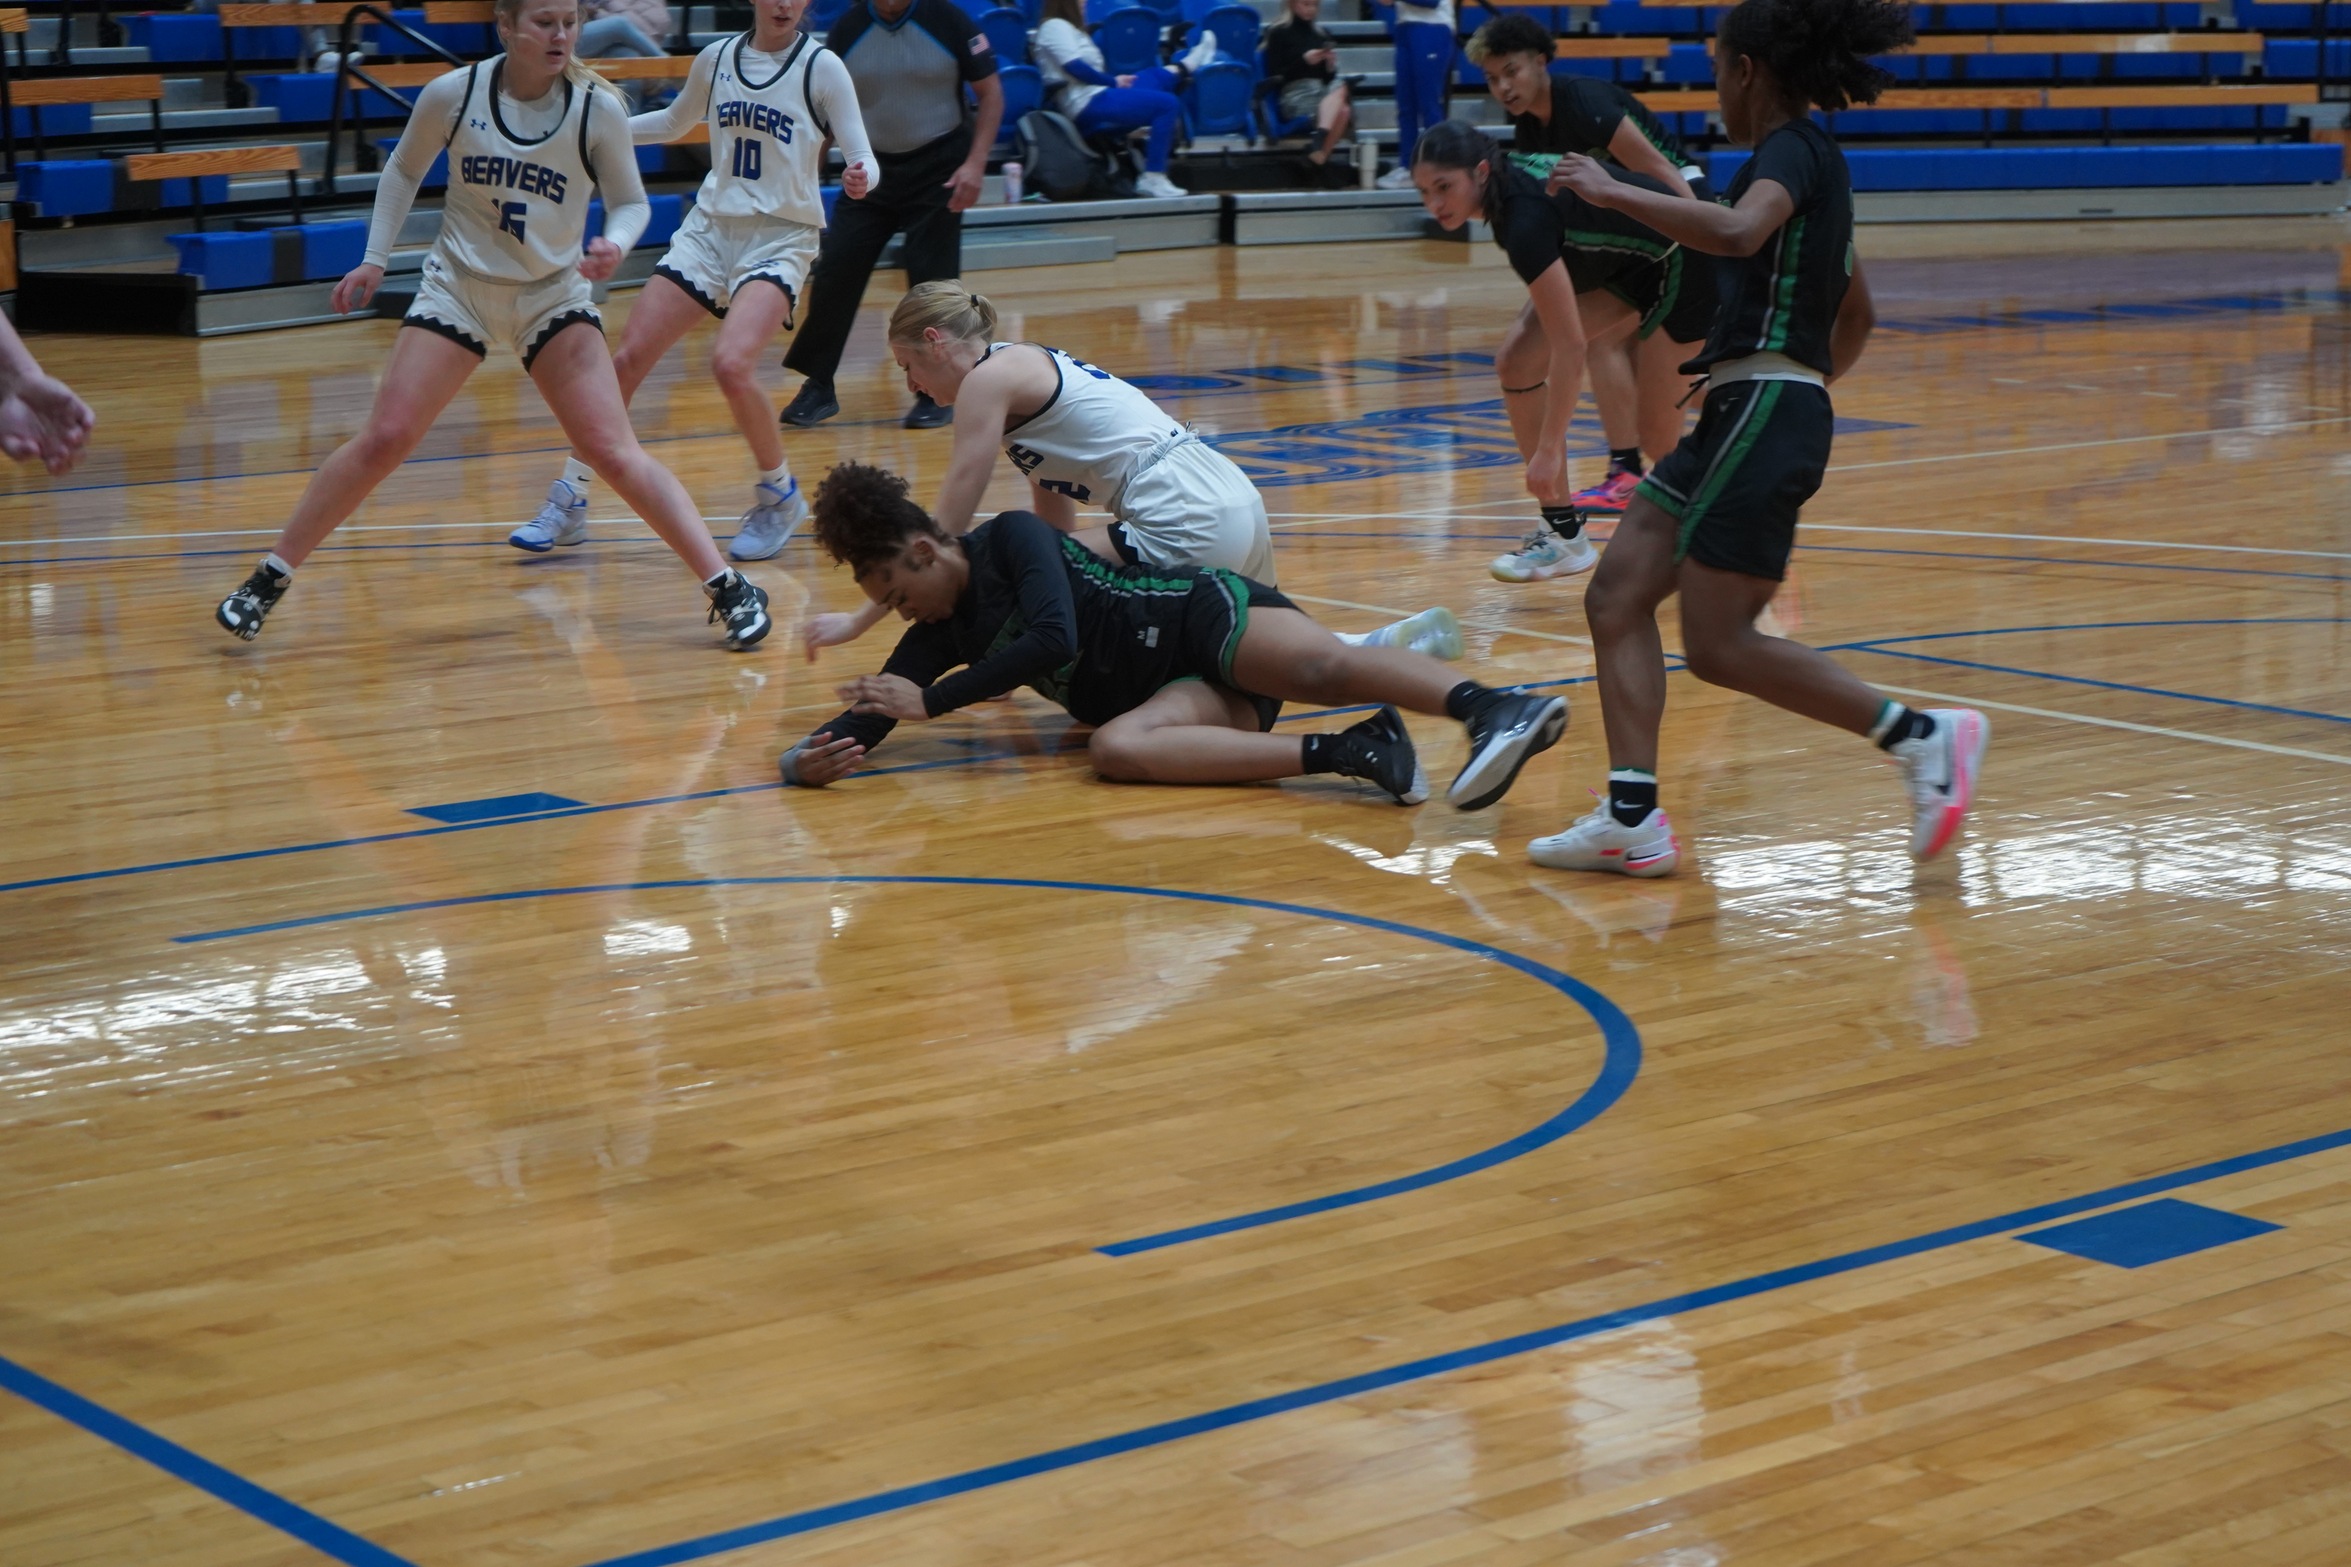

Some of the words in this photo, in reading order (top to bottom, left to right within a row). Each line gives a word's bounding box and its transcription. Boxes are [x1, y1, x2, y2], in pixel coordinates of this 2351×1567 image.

[717, 101, 794, 145] EAVERS
[462, 155, 568, 205] BEAVERS
[732, 136, 762, 181] 10
